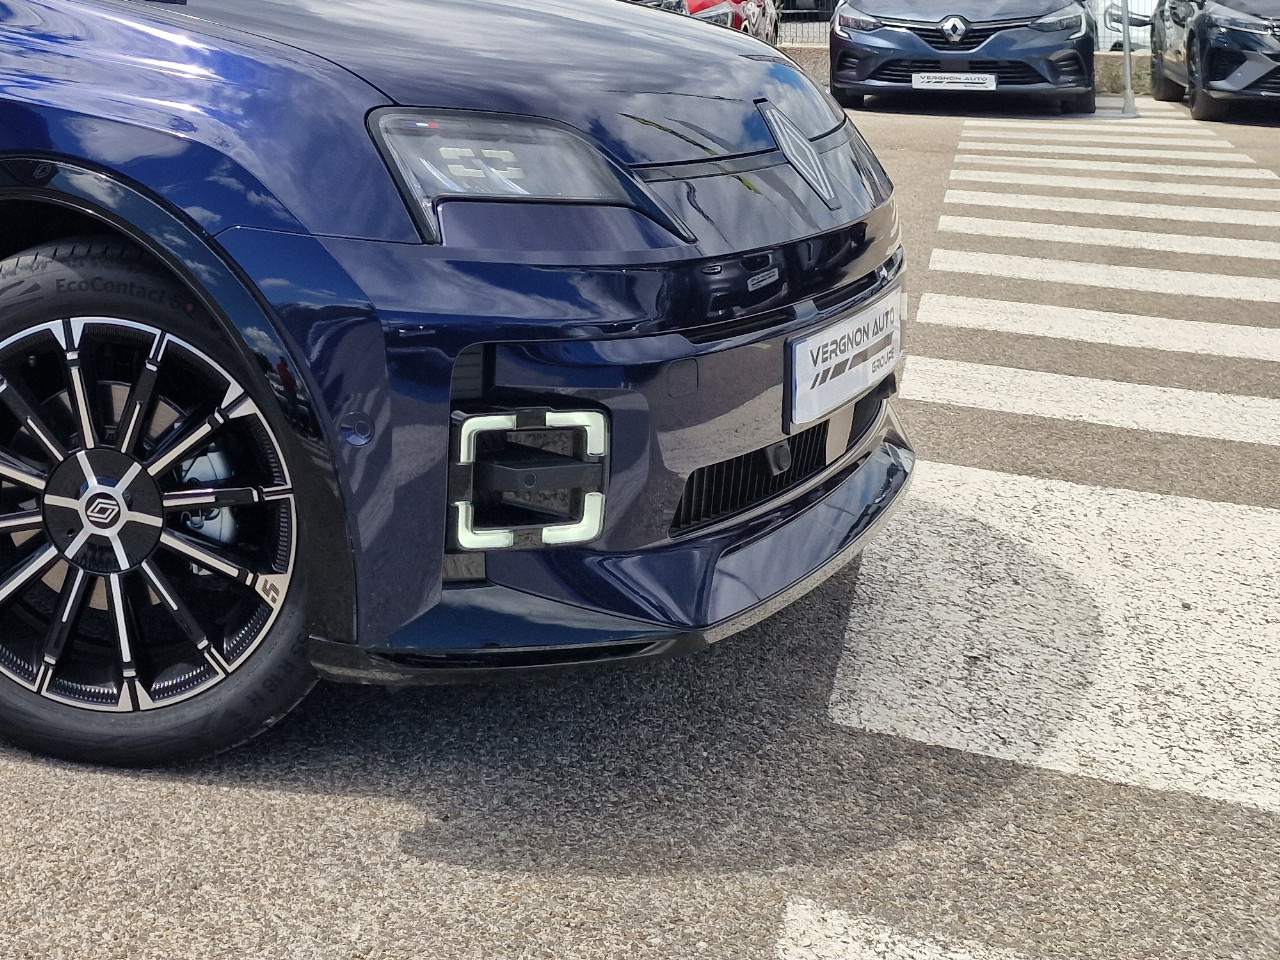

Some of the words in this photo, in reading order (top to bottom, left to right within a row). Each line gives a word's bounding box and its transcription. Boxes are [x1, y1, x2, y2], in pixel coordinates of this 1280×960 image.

[55, 276, 165, 303] EcoContact
[810, 322, 870, 367] VERGNON
[872, 307, 894, 338] AUTO
[871, 347, 894, 373] GROUPE
